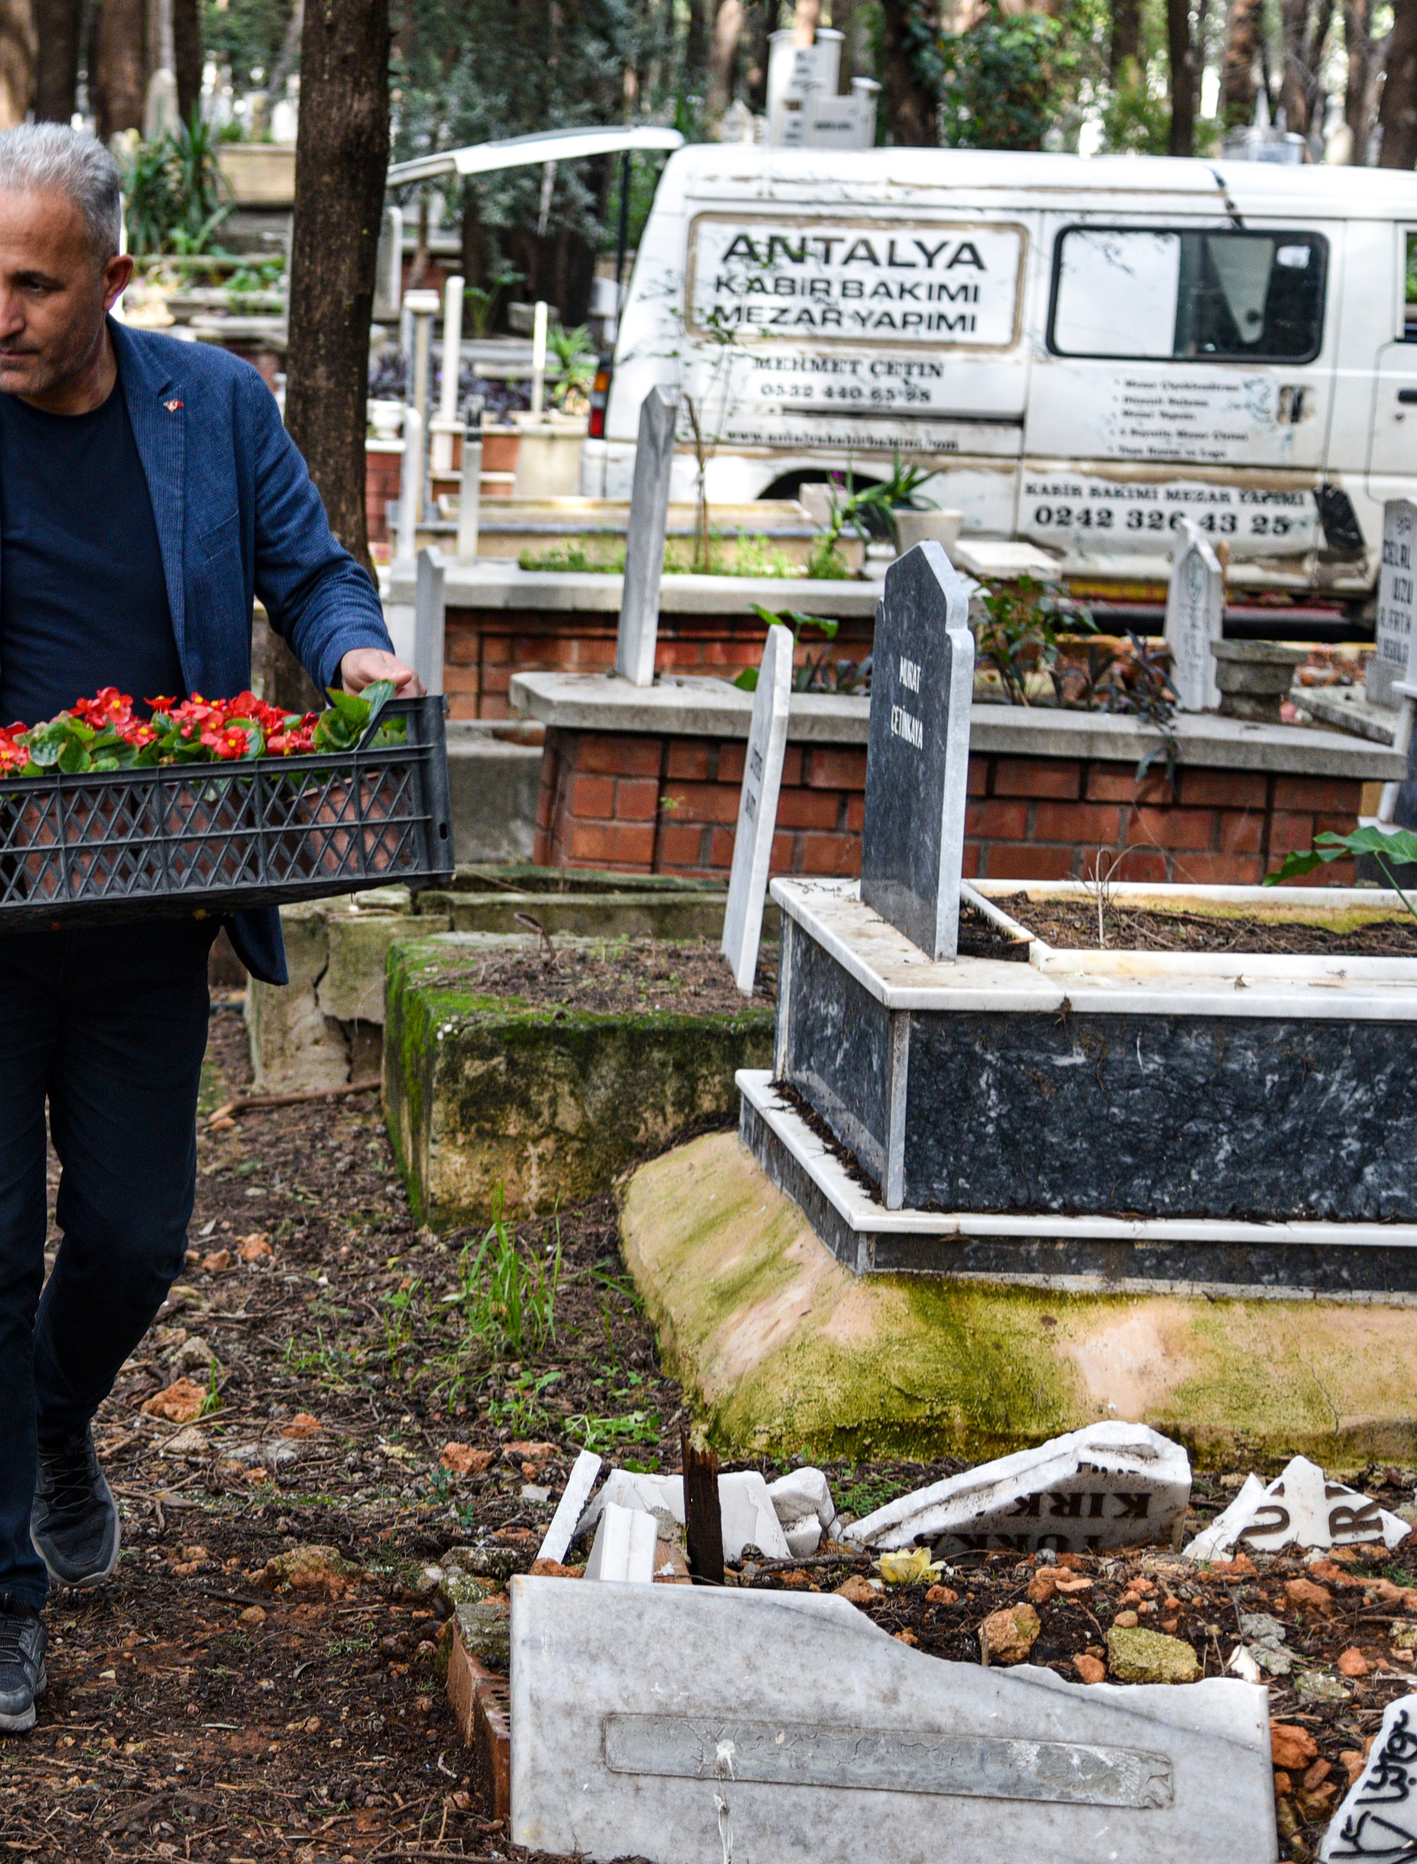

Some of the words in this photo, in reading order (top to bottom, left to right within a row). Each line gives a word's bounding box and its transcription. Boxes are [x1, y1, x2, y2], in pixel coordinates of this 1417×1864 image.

[721, 233, 987, 270] ANTALYA
[841, 279, 980, 304] BAKIMI
[712, 304, 844, 327] MEZAR
[852, 309, 977, 333] YAPIMI
[752, 357, 862, 376] MEHMET
[1034, 505, 1113, 529] 0242
[1126, 509, 1186, 531] 326
[1198, 512, 1238, 534] 43
[899, 656, 922, 694] MURAT
